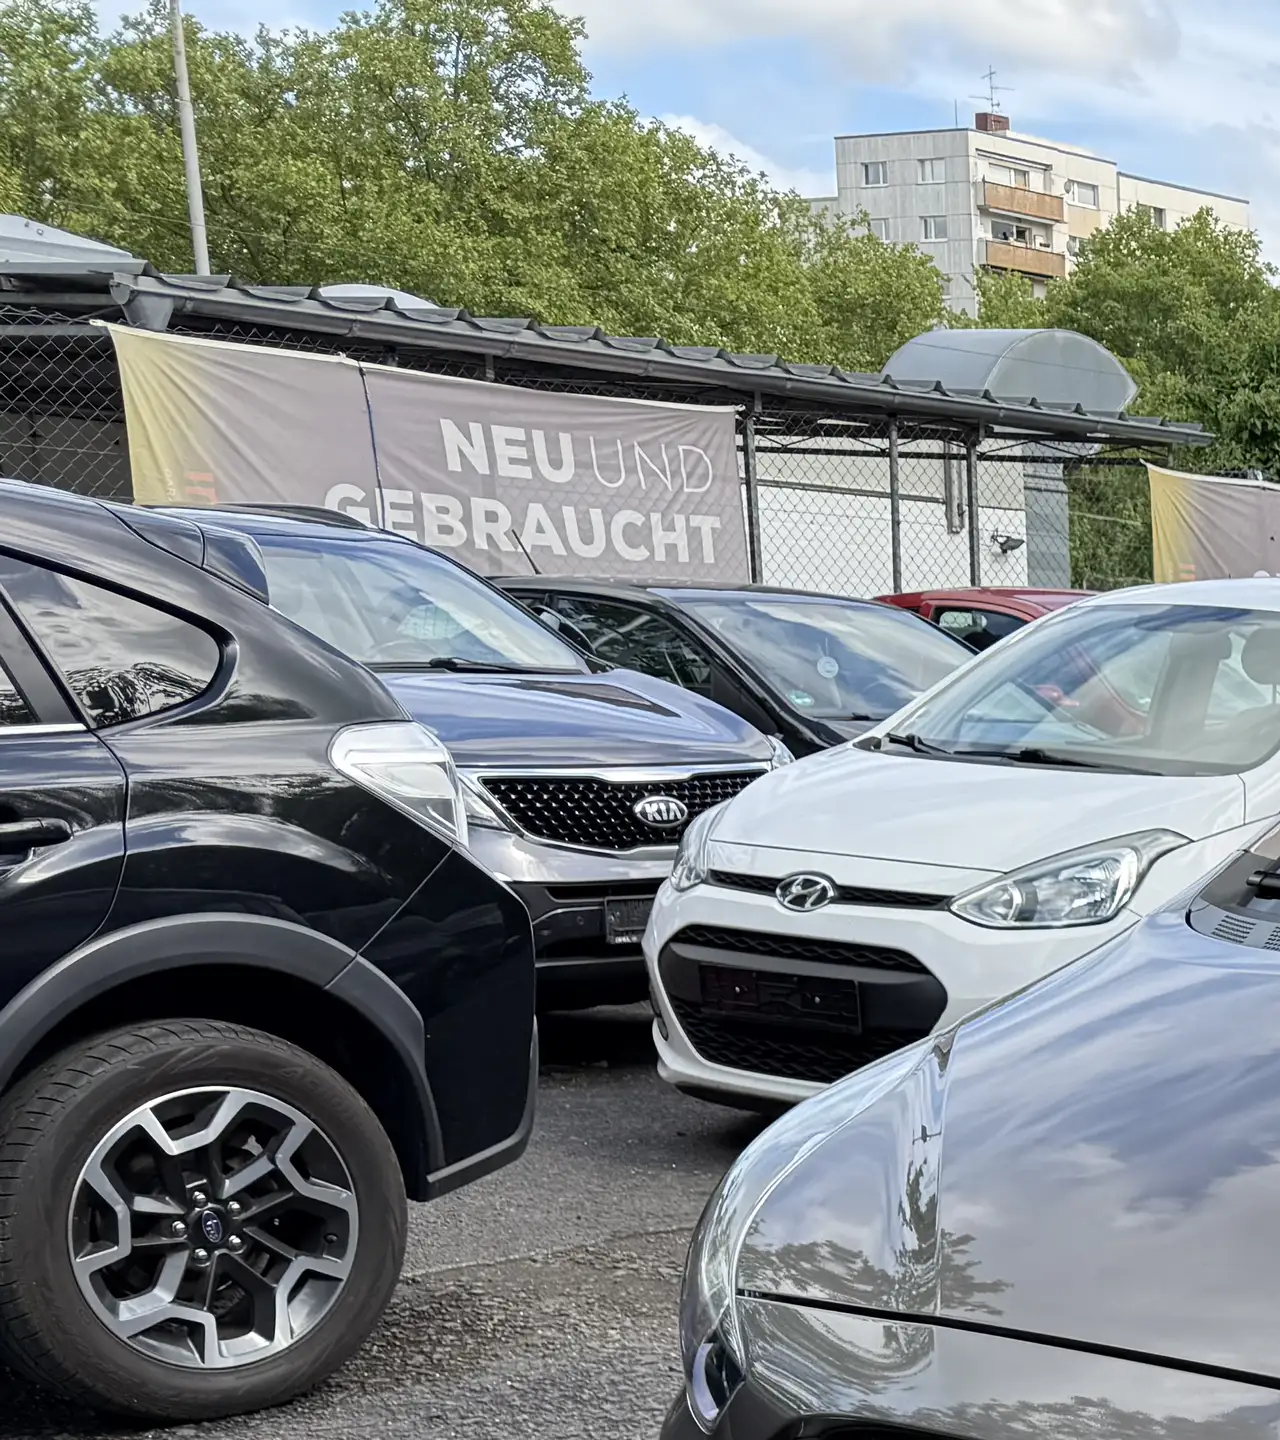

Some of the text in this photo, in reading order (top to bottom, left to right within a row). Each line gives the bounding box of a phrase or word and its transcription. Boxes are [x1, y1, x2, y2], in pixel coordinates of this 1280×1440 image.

[439, 417, 714, 493] NEU UND
[324, 484, 721, 564] GEBRAUCHT
[644, 801, 682, 822] KIA
